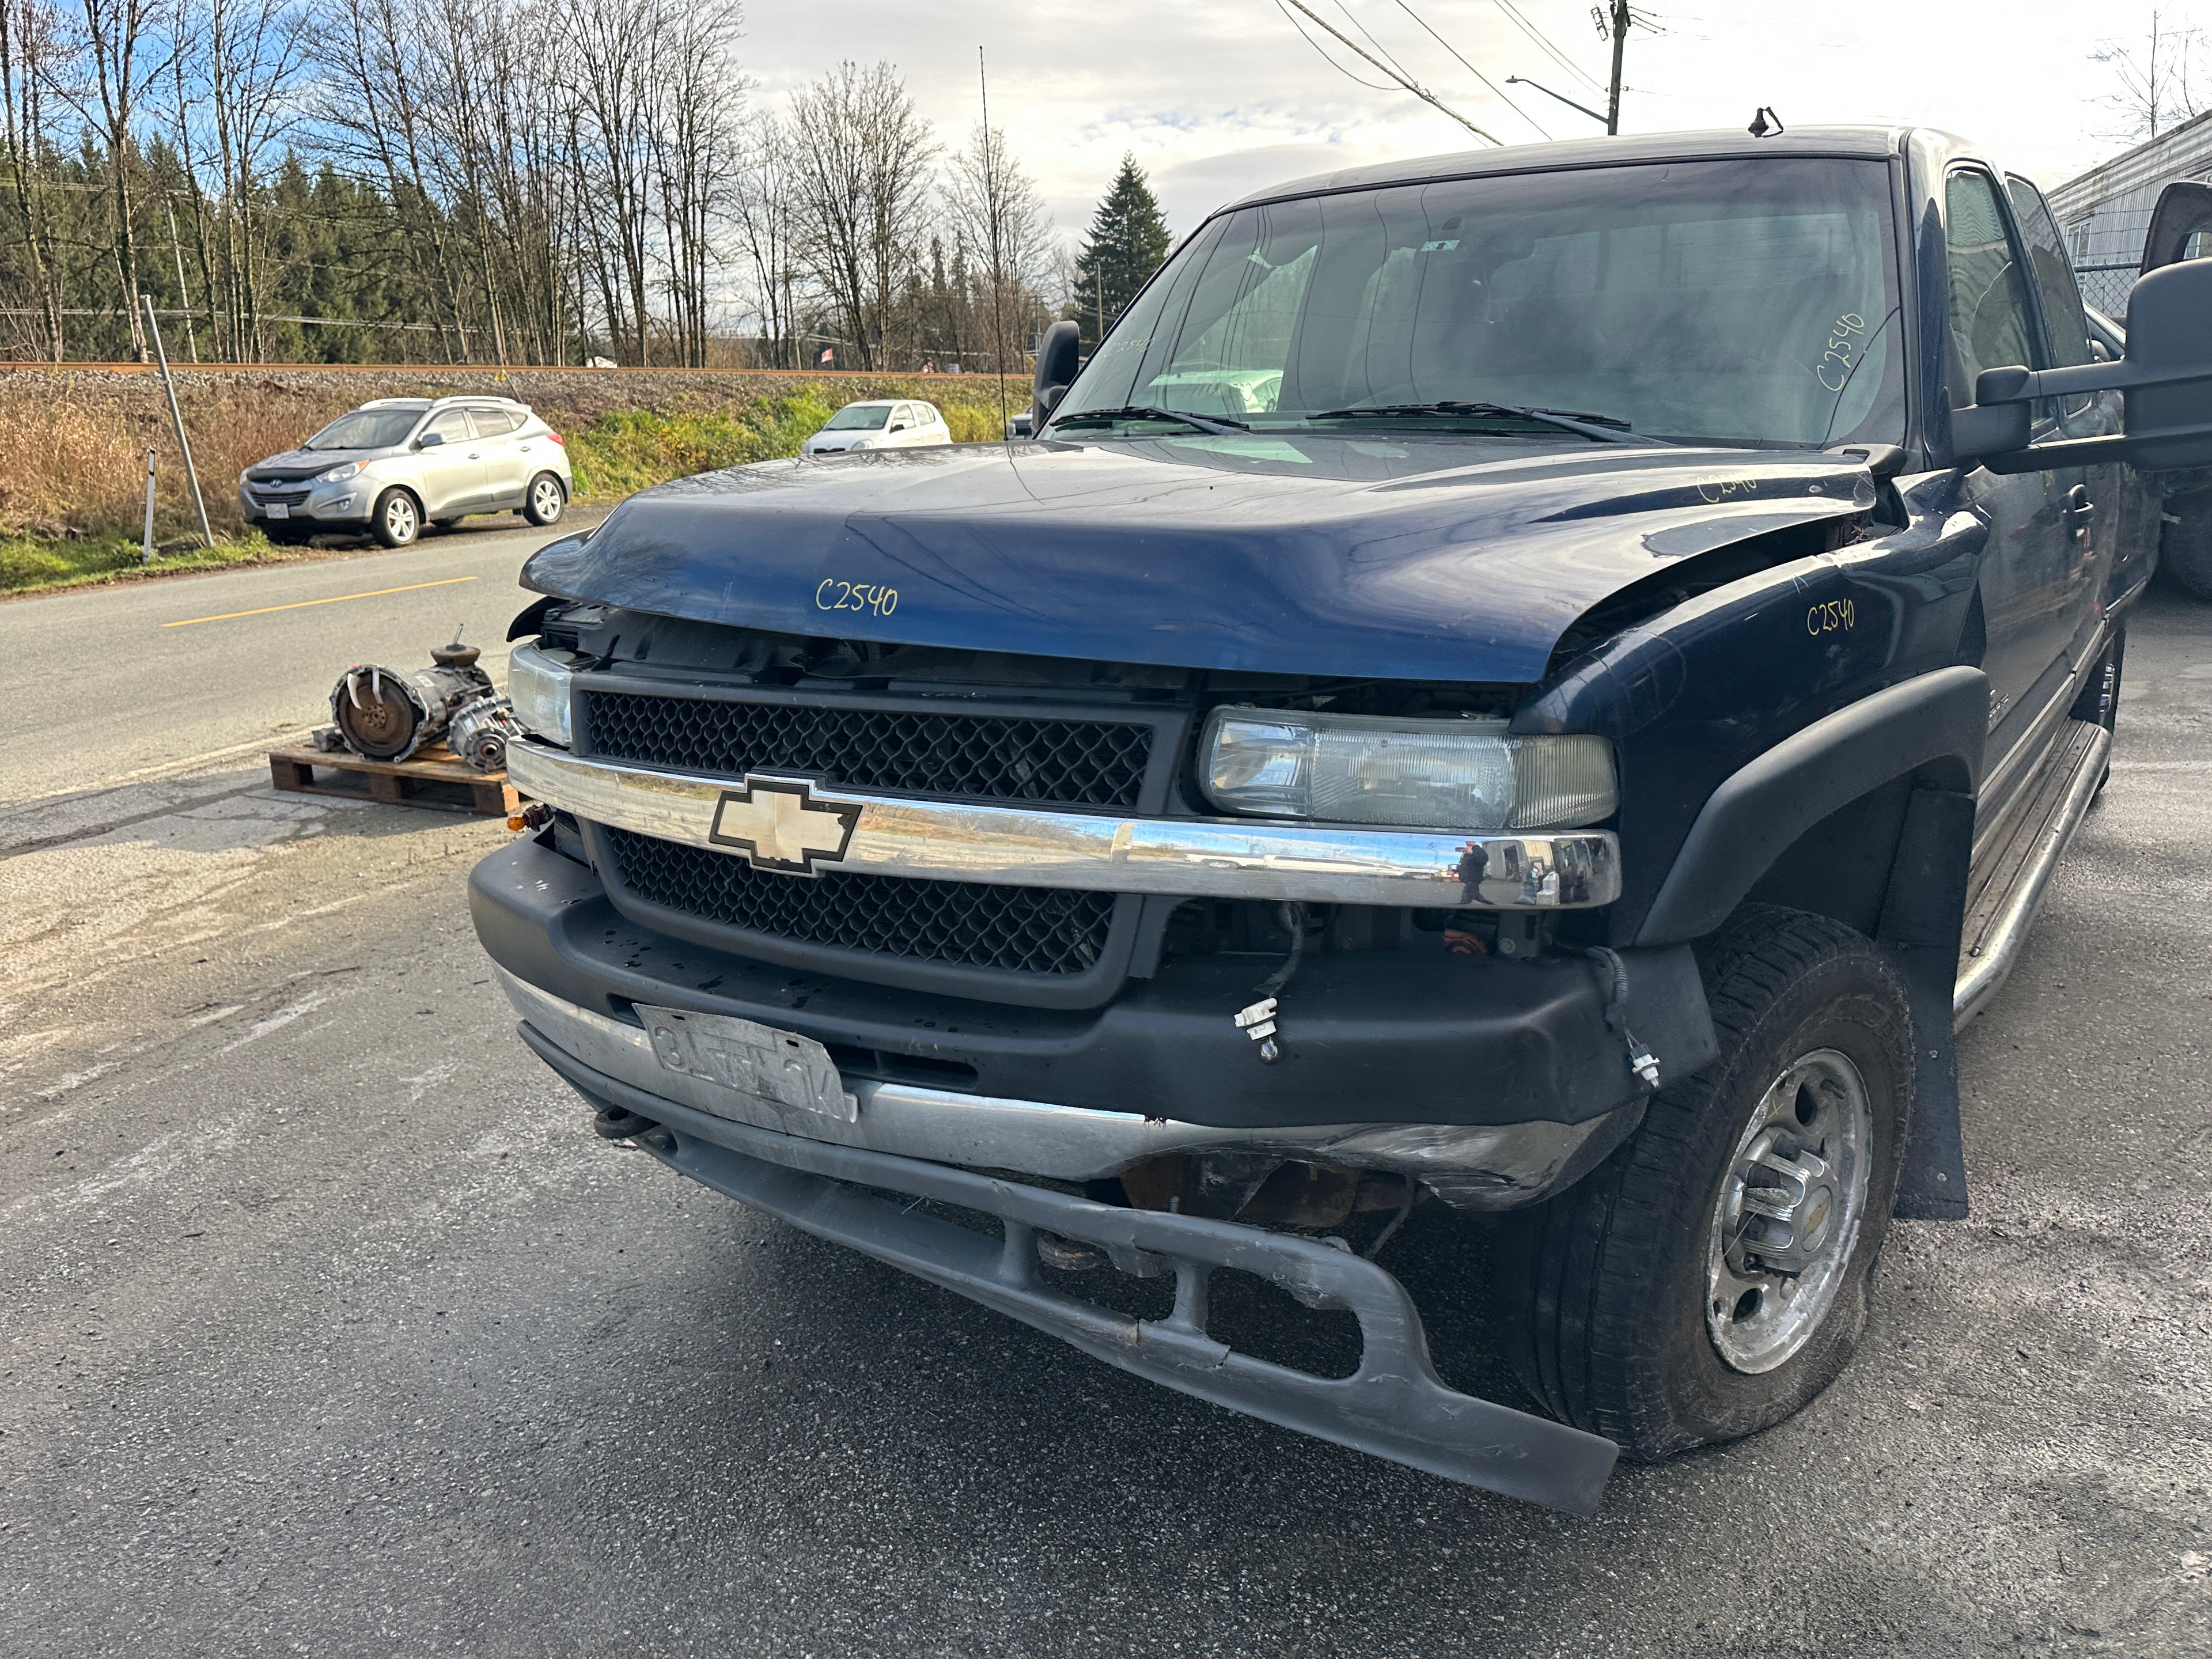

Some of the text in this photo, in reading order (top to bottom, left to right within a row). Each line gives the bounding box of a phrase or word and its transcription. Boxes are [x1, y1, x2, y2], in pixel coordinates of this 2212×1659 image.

[1104, 337, 1156, 358] C2540
[1817, 313, 1865, 391] C2540
[816, 578, 898, 616] C2540
[1807, 598, 1854, 635] C2540
